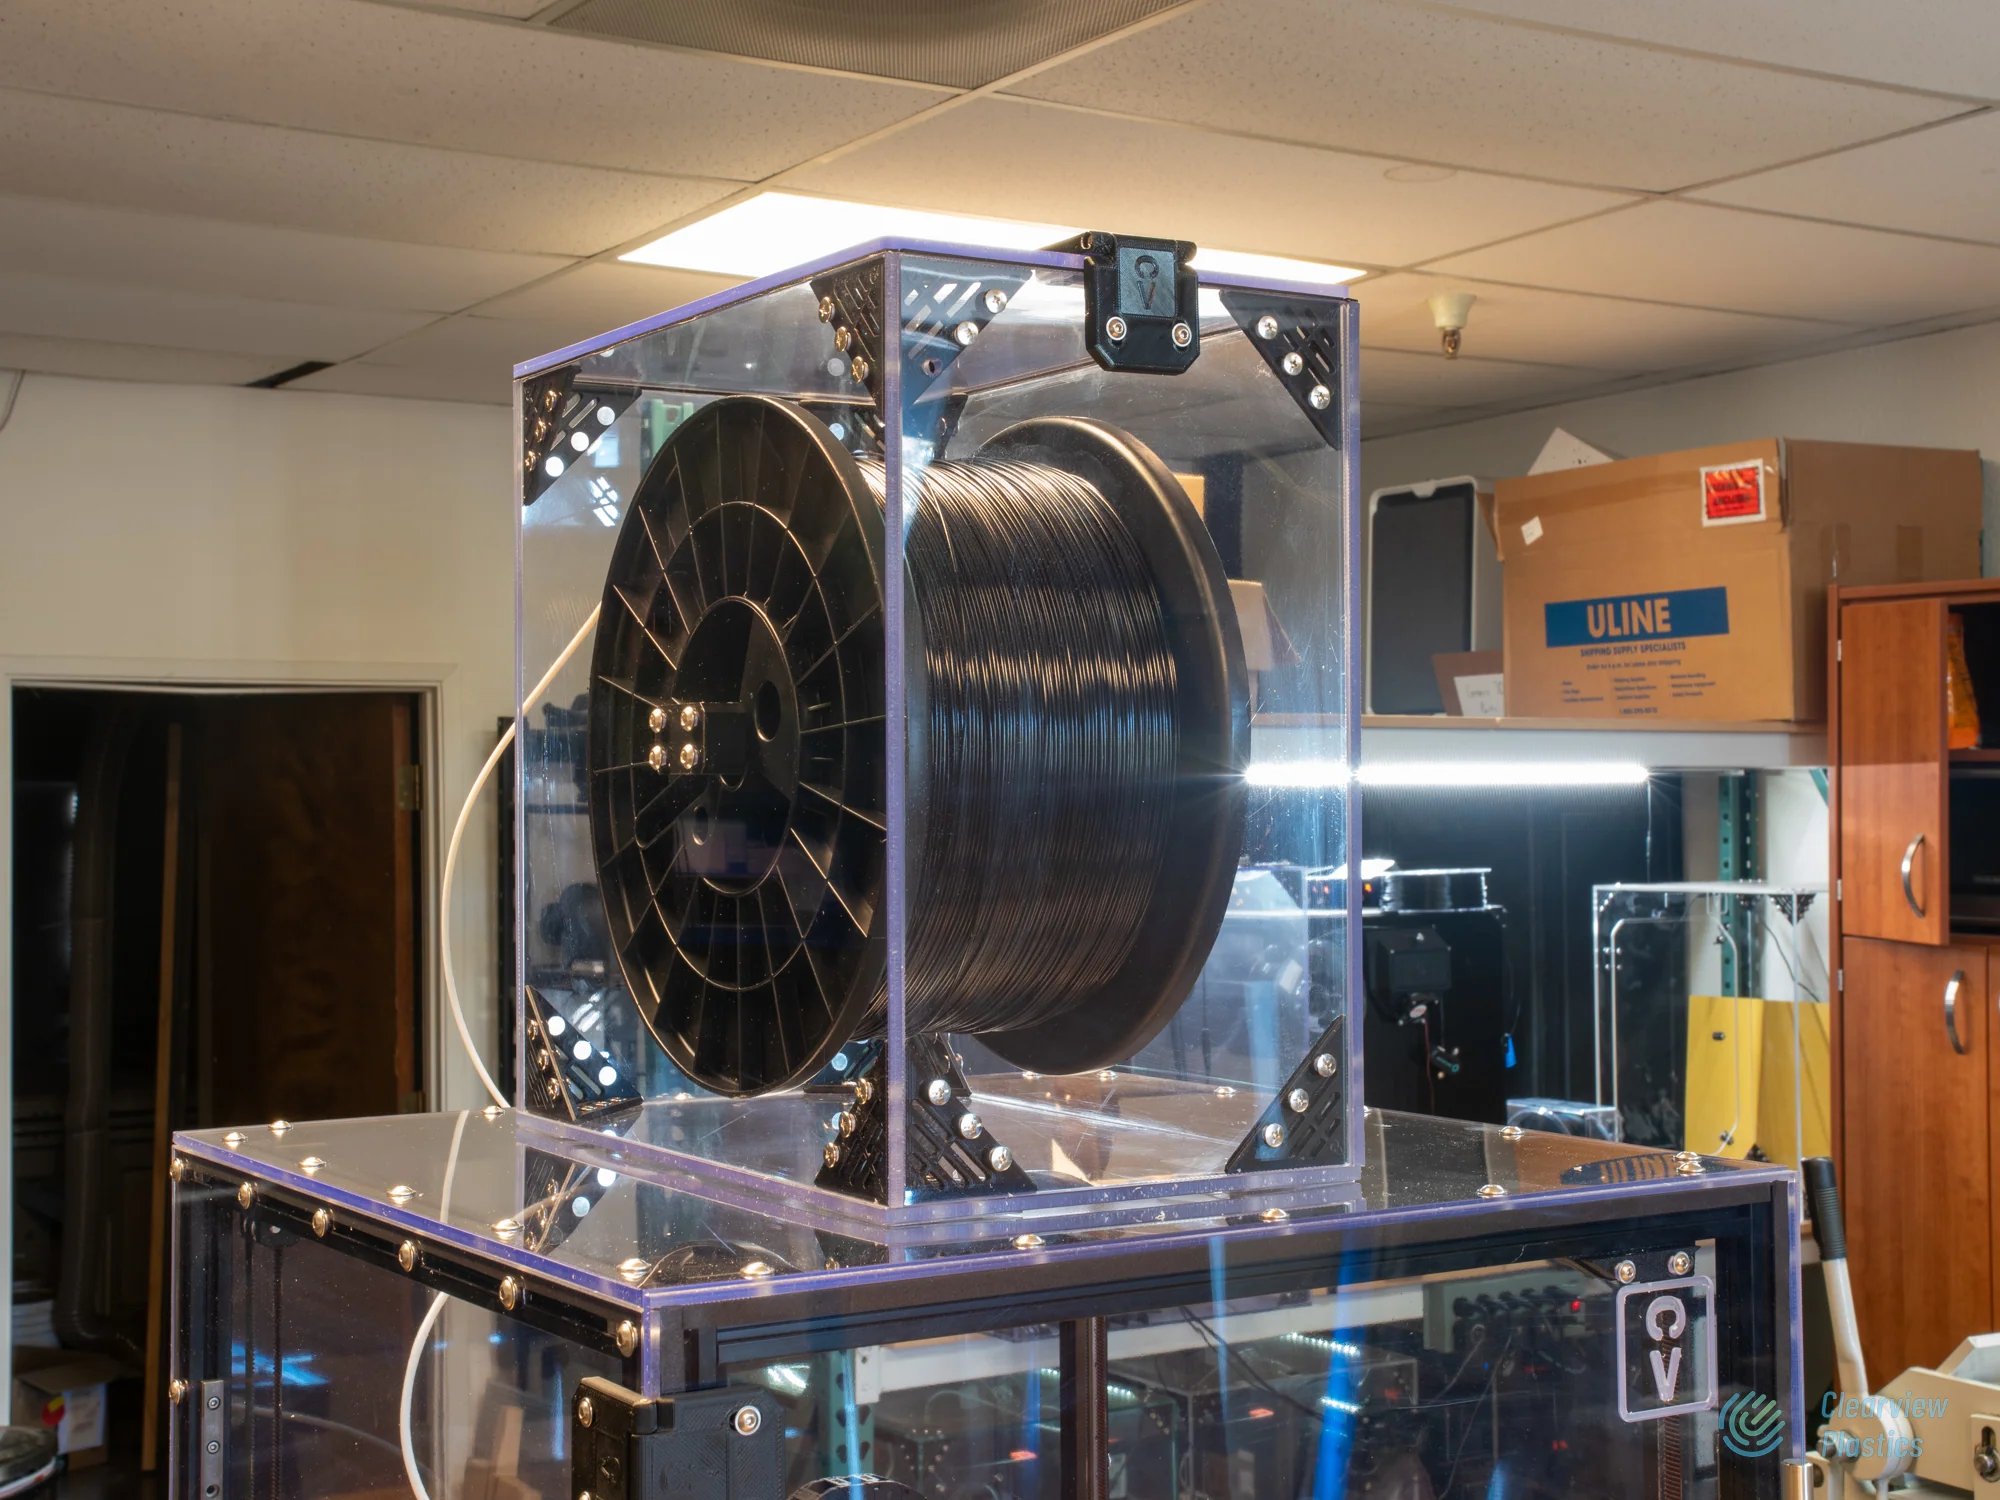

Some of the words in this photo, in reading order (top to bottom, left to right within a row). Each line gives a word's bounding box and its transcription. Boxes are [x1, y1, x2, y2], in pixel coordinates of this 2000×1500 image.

[1587, 598, 1672, 638] ULINE
[1580, 647, 1612, 657] SHIPPING
[1613, 645, 1638, 656] SUPPLY
[1640, 641, 1686, 654] SPECIALISTS
